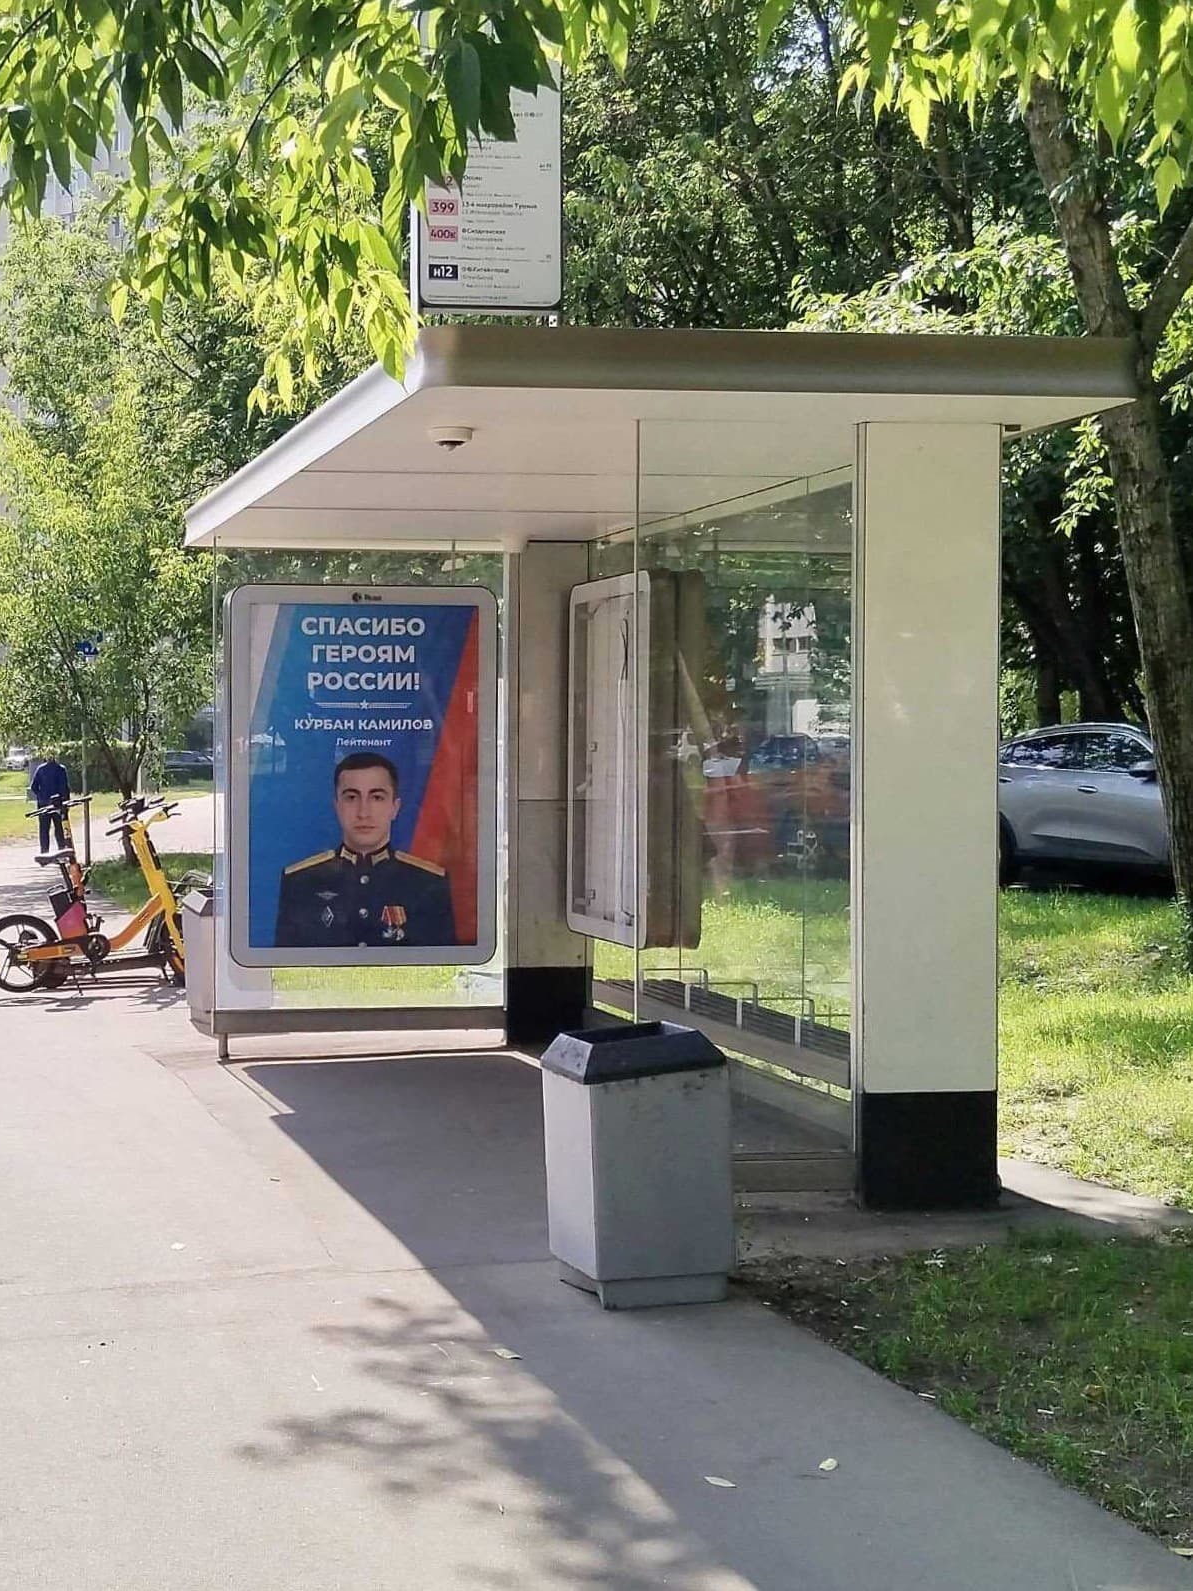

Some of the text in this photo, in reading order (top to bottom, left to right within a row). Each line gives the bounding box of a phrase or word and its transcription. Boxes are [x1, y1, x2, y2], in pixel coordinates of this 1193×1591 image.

[432, 202, 455, 213] 399
[301, 617, 425, 636] СПАСИБО
[312, 644, 415, 663] ГЕРОЯМ
[308, 672, 420, 691] РОССИИ!
[294, 718, 433, 731] КУРБАН КАМИЛОВ
[336, 738, 392, 748] Лейтенант
